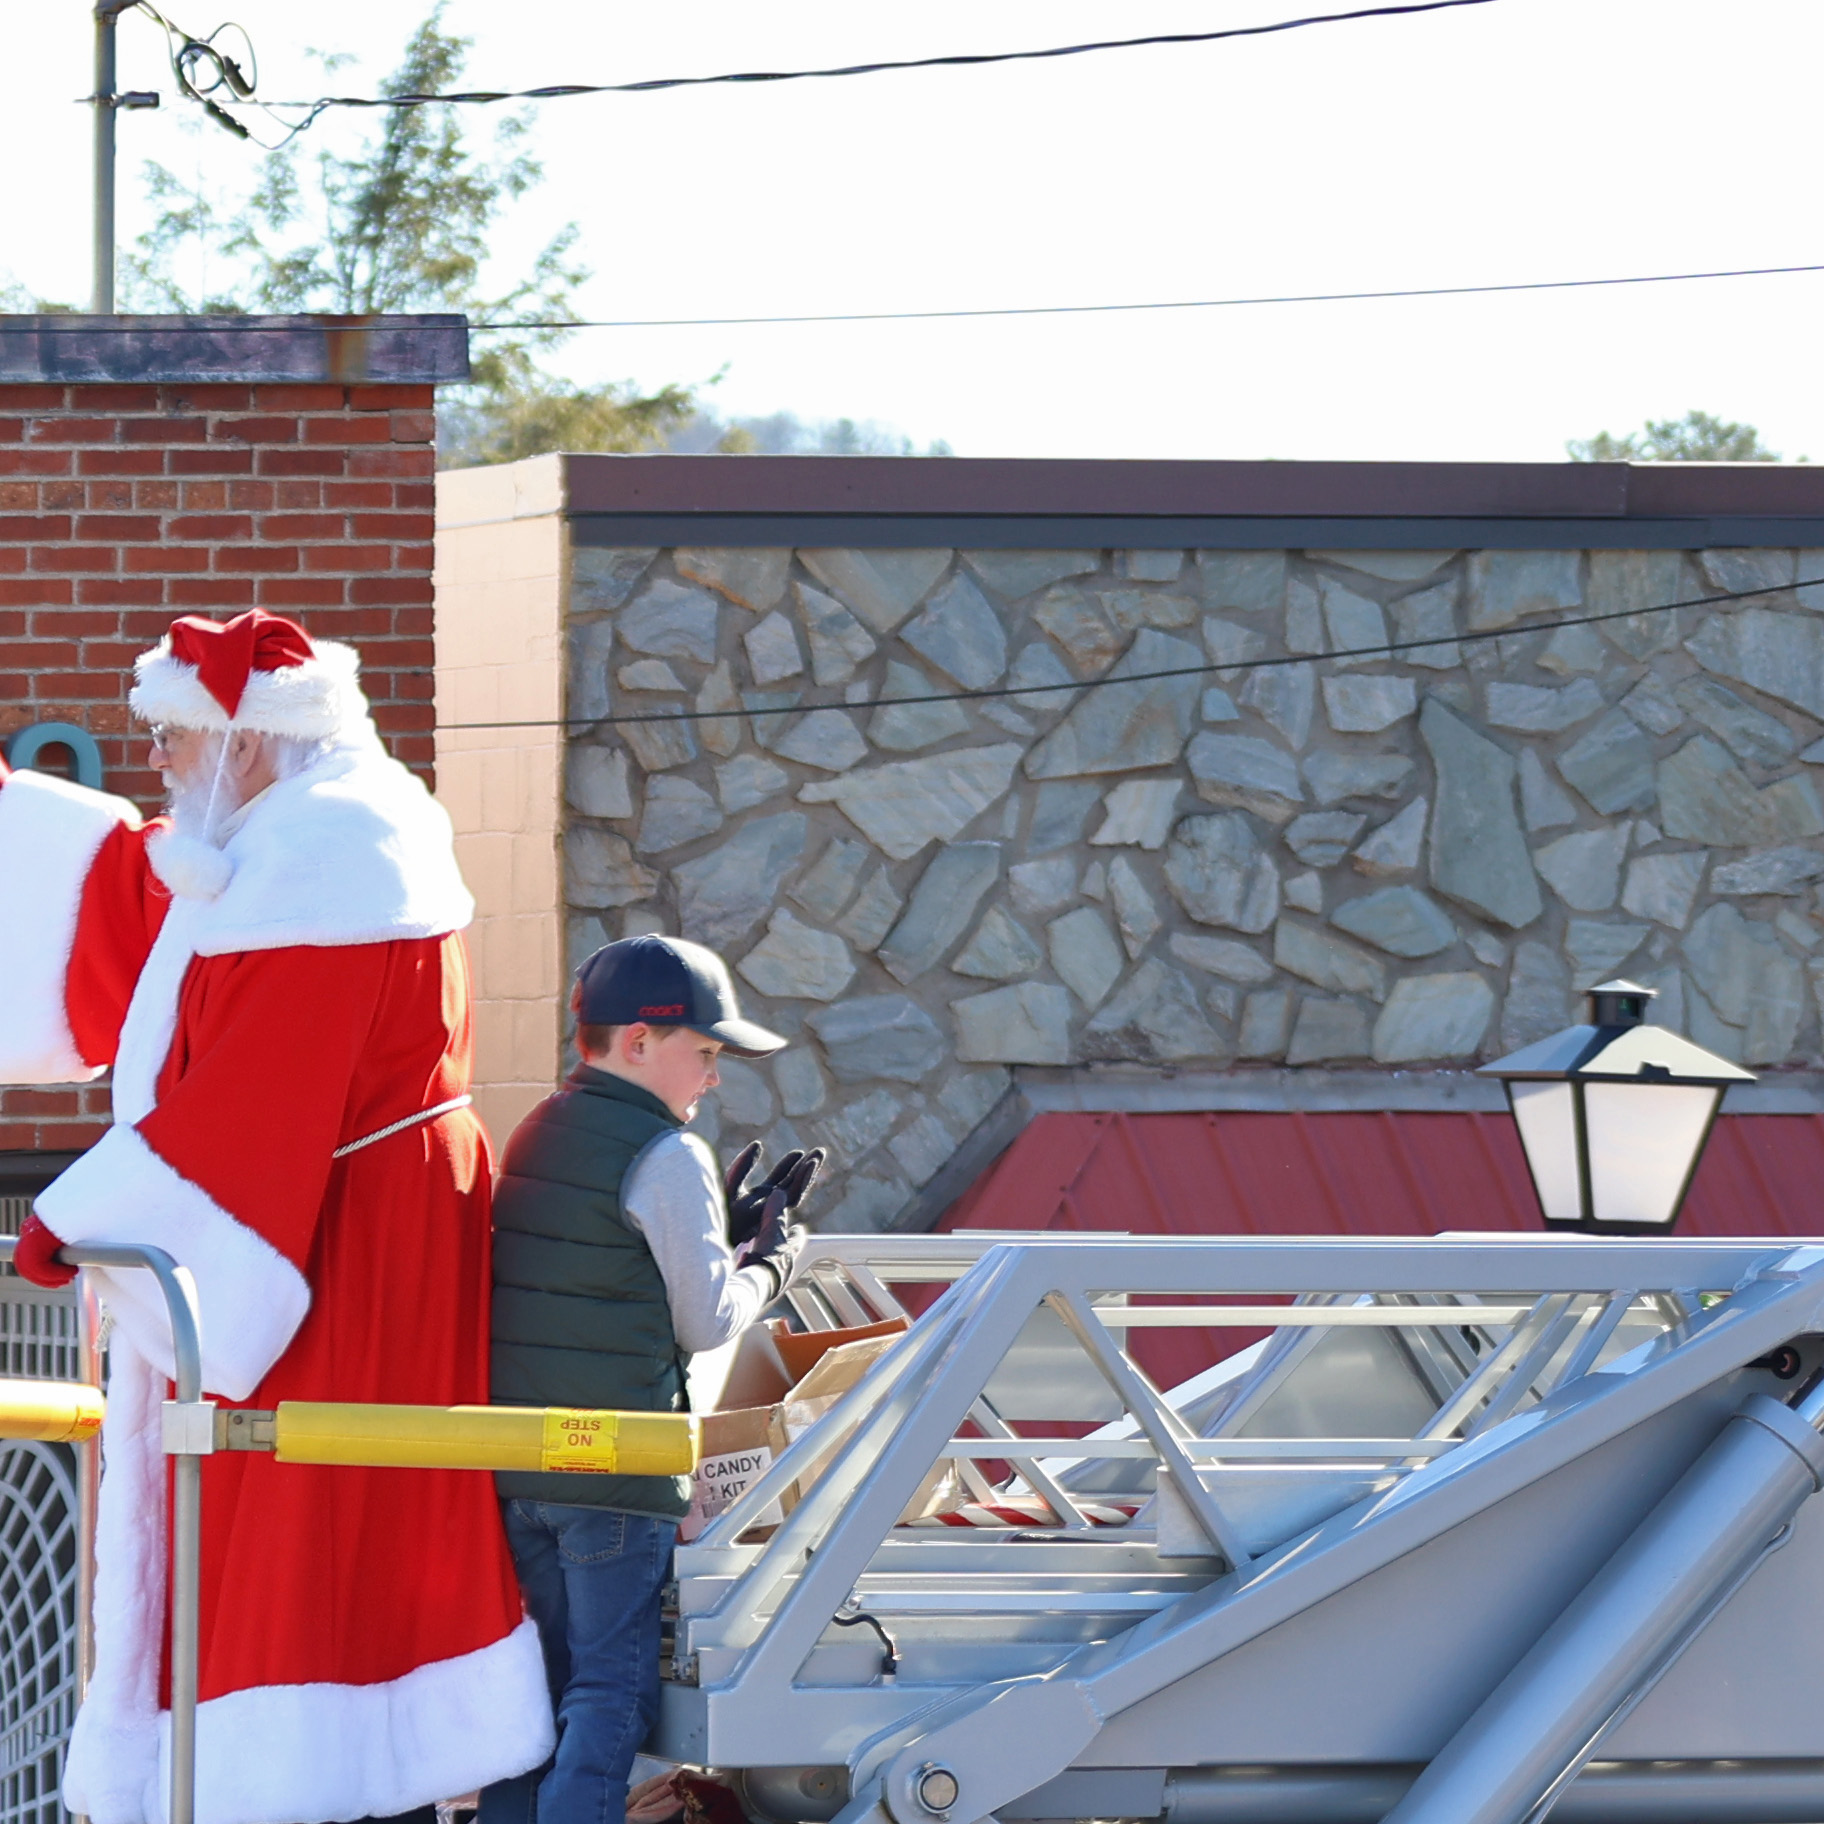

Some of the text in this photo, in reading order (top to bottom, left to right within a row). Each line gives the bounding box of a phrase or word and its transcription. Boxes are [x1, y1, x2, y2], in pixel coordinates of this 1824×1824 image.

[560, 1419, 601, 1431] STEP
[567, 1433, 592, 1447] NO
[704, 1454, 762, 1479] CANDY
